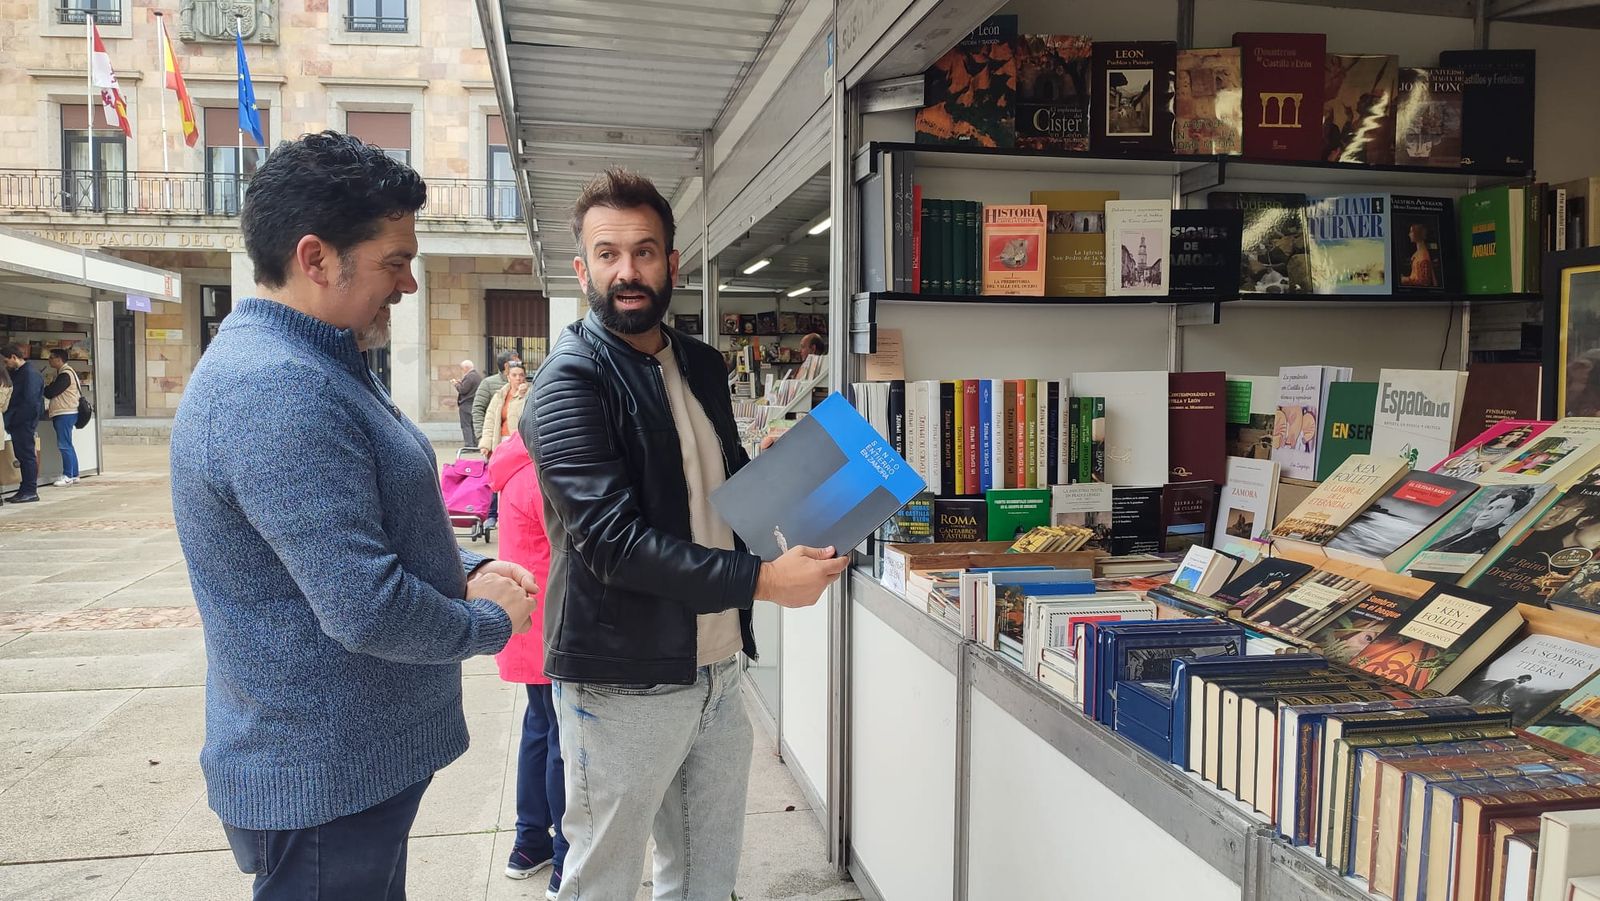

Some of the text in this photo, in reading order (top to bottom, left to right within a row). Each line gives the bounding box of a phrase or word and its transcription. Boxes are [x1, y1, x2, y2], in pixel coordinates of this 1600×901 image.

[1115, 50, 1145, 59] LEON
[1463, 73, 1486, 84] astillos
[1033, 108, 1083, 132] Císter
[985, 207, 1044, 224] HISTORIA
[1171, 226, 1228, 240] SIONES
[1307, 214, 1384, 240] TURNER
[179, 233, 215, 249] DEL
[1184, 242, 1199, 251] DE
[1472, 242, 1497, 258] ANDALUZ
[865, 443, 896, 477] ENTIERRO
[871, 439, 901, 472] SANTO
[859, 448, 891, 482] EN ZAMORA
[1353, 463, 1381, 473] KEN
[1332, 472, 1381, 486] FOLLETT
[1231, 487, 1258, 499] ZAMORA
[941, 513, 978, 526] ROMA
[946, 533, 976, 541] ASTURES
[1518, 559, 1548, 572] Reino
[1486, 566, 1533, 584] Dragón
[1510, 581, 1532, 592] Oro
[1366, 595, 1398, 609] Sombras
[1373, 606, 1403, 619] bosque
[1440, 606, 1464, 618] KEN
[1421, 611, 1467, 630] FOLLETT
[1520, 646, 1594, 671] LA SOMBRA
[1516, 660, 1565, 679] TIERRA
